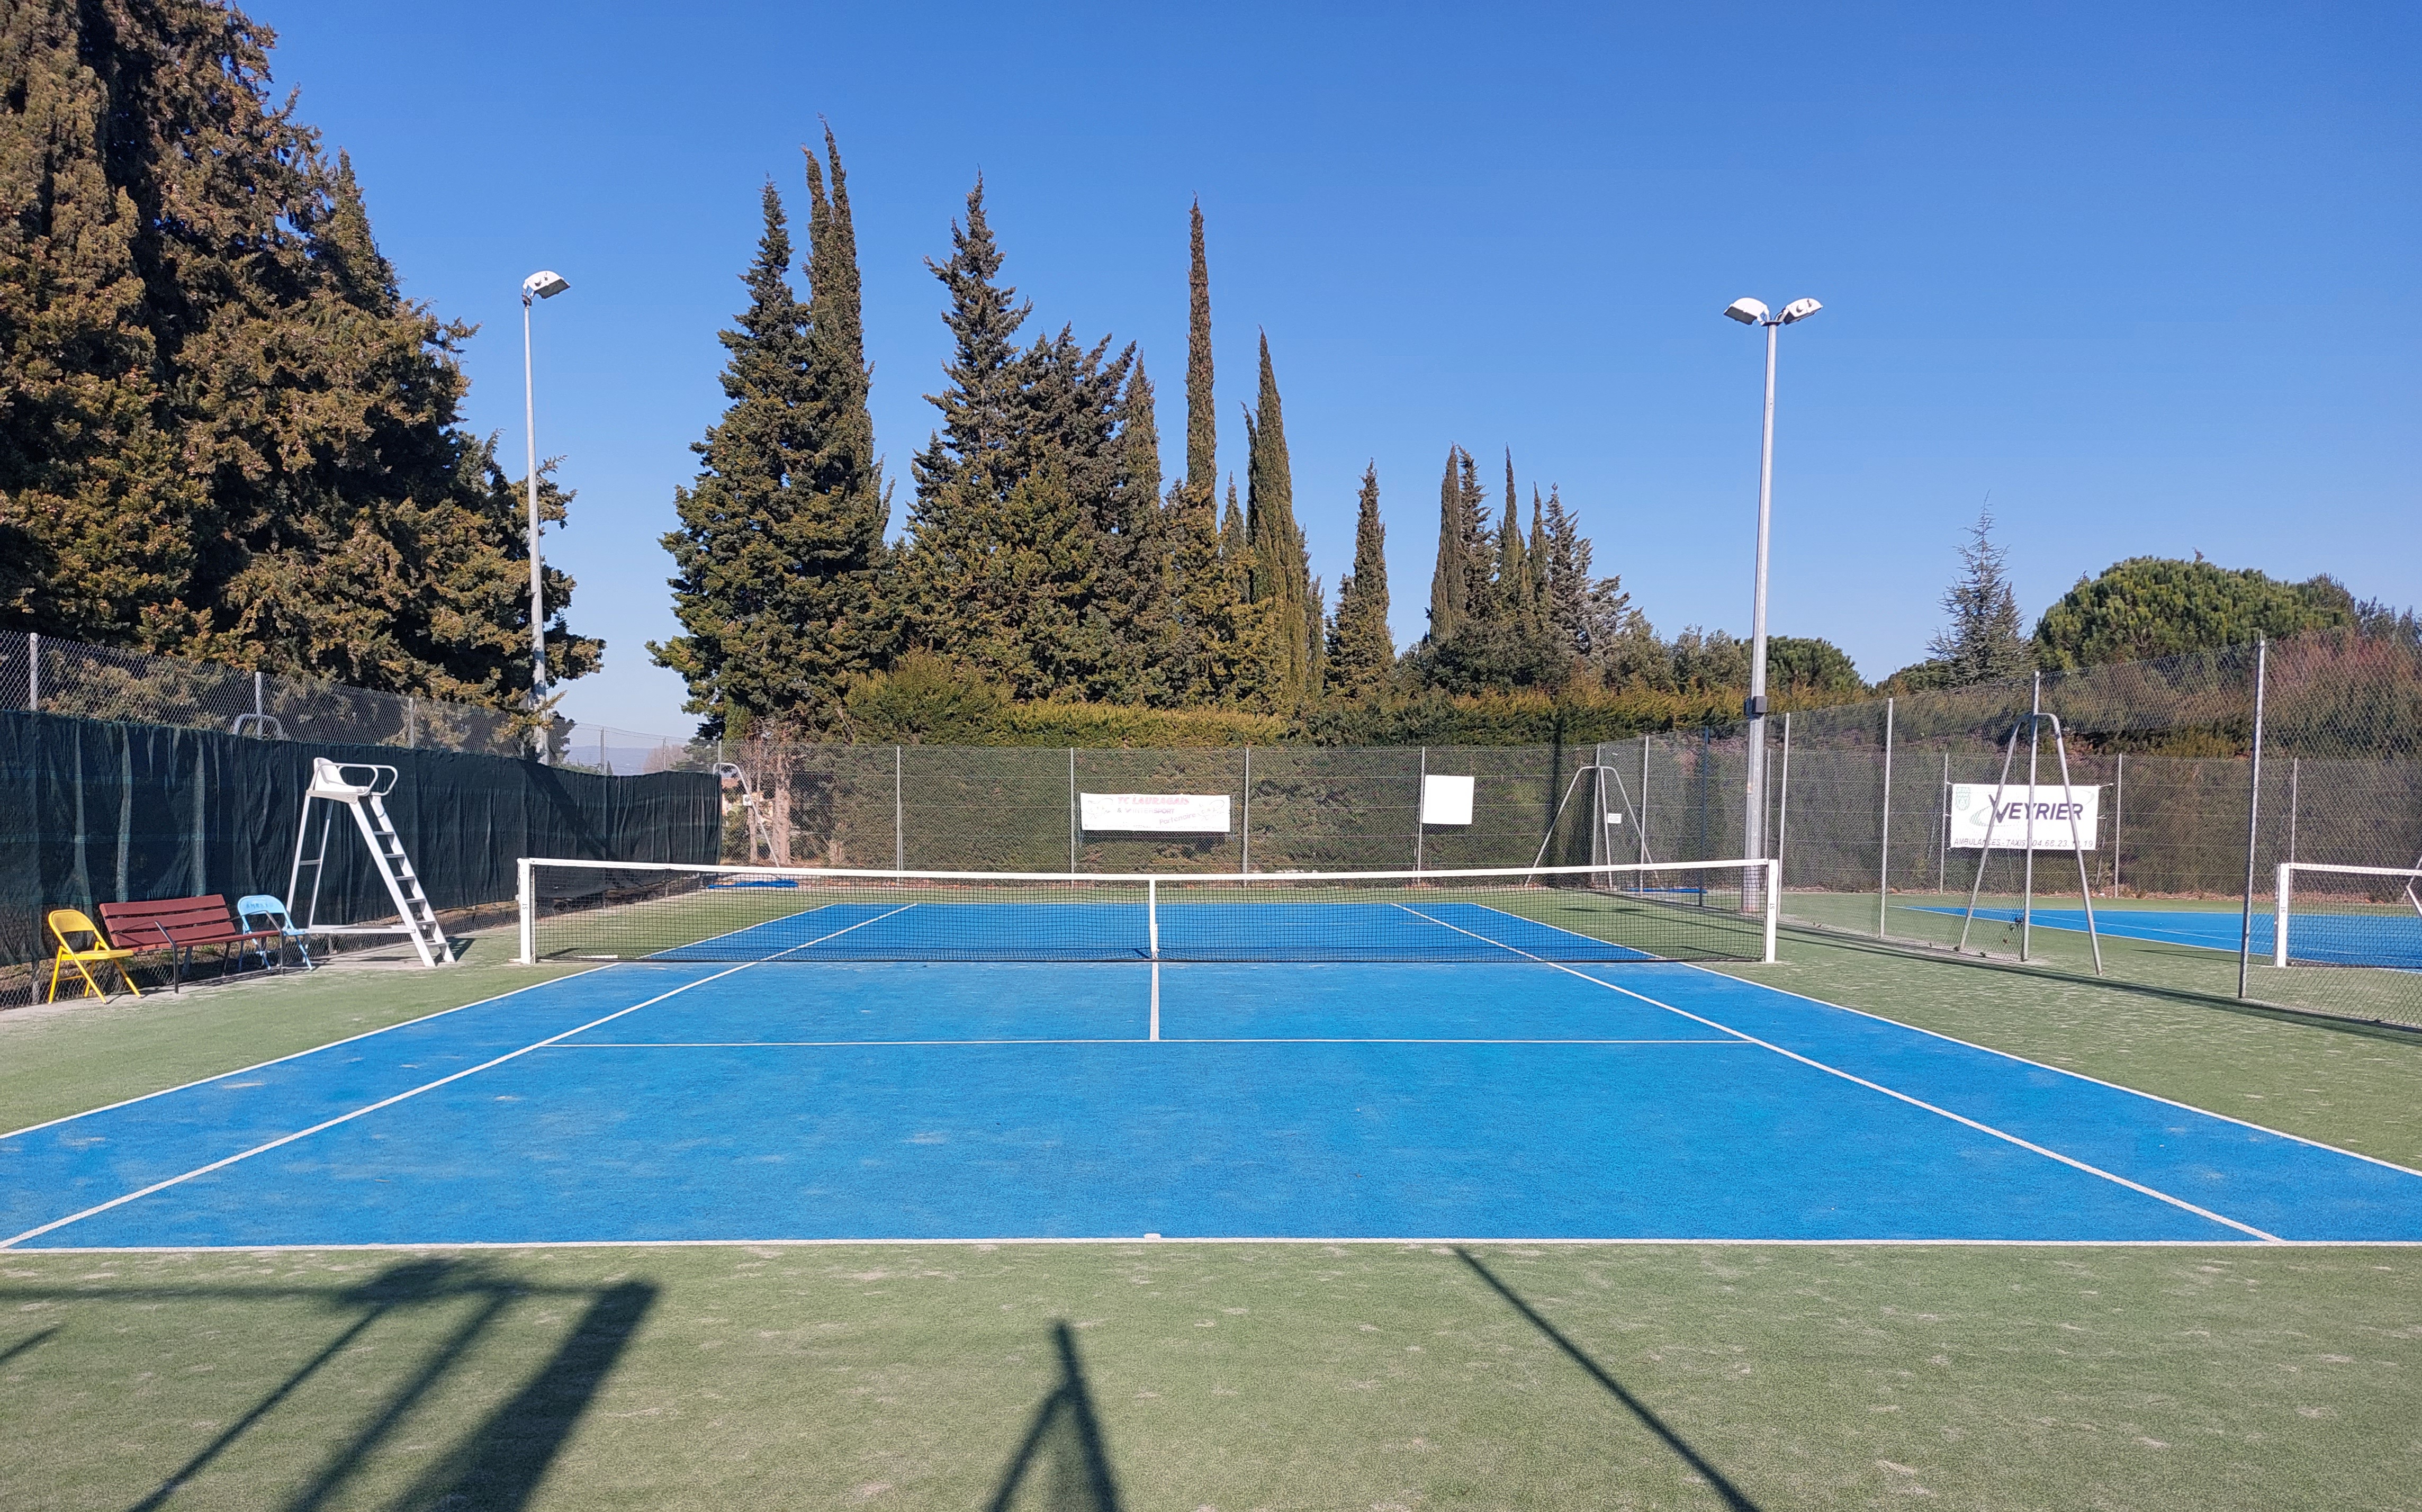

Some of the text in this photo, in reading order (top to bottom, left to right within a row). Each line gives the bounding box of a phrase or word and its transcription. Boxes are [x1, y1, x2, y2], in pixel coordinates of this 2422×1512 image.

[1132, 797, 1190, 805] LAURAGAIS
[1988, 794, 2084, 823] VEYRIER
[1159, 813, 1196, 825] Partenaire
[2006, 839, 2025, 847] TAXIS
